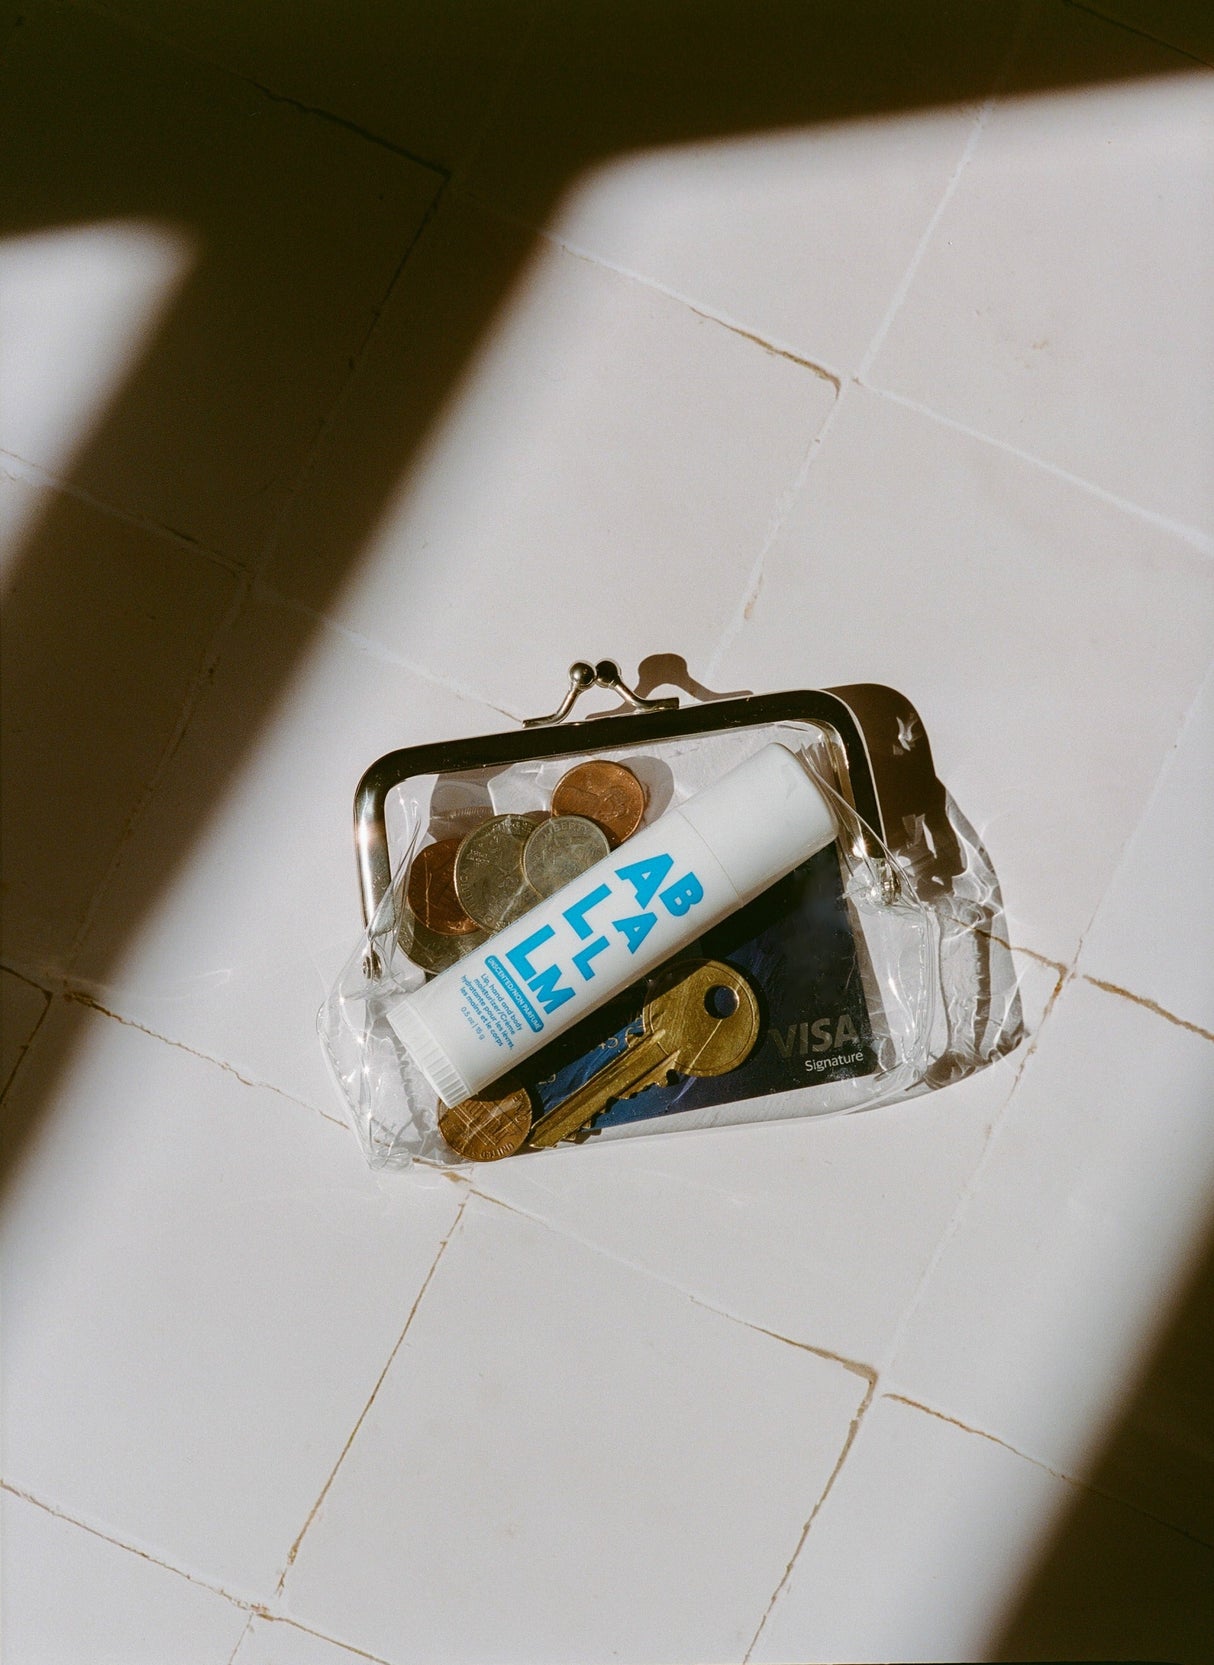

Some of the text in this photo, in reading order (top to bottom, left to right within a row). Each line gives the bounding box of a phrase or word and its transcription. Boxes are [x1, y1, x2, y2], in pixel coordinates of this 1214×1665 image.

[460, 986, 468, 997] les
[466, 995, 483, 1016] mains
[480, 1014, 489, 1024] et
[490, 1028, 503, 1047] corps
[483, 1005, 497, 1022] pour
[495, 1020, 503, 1032] les
[489, 983, 503, 1002] hand
[501, 1001, 512, 1015] and
[510, 1013, 522, 1031] body
[767, 1014, 858, 1058] VISA
[804, 1051, 864, 1072] Signature
